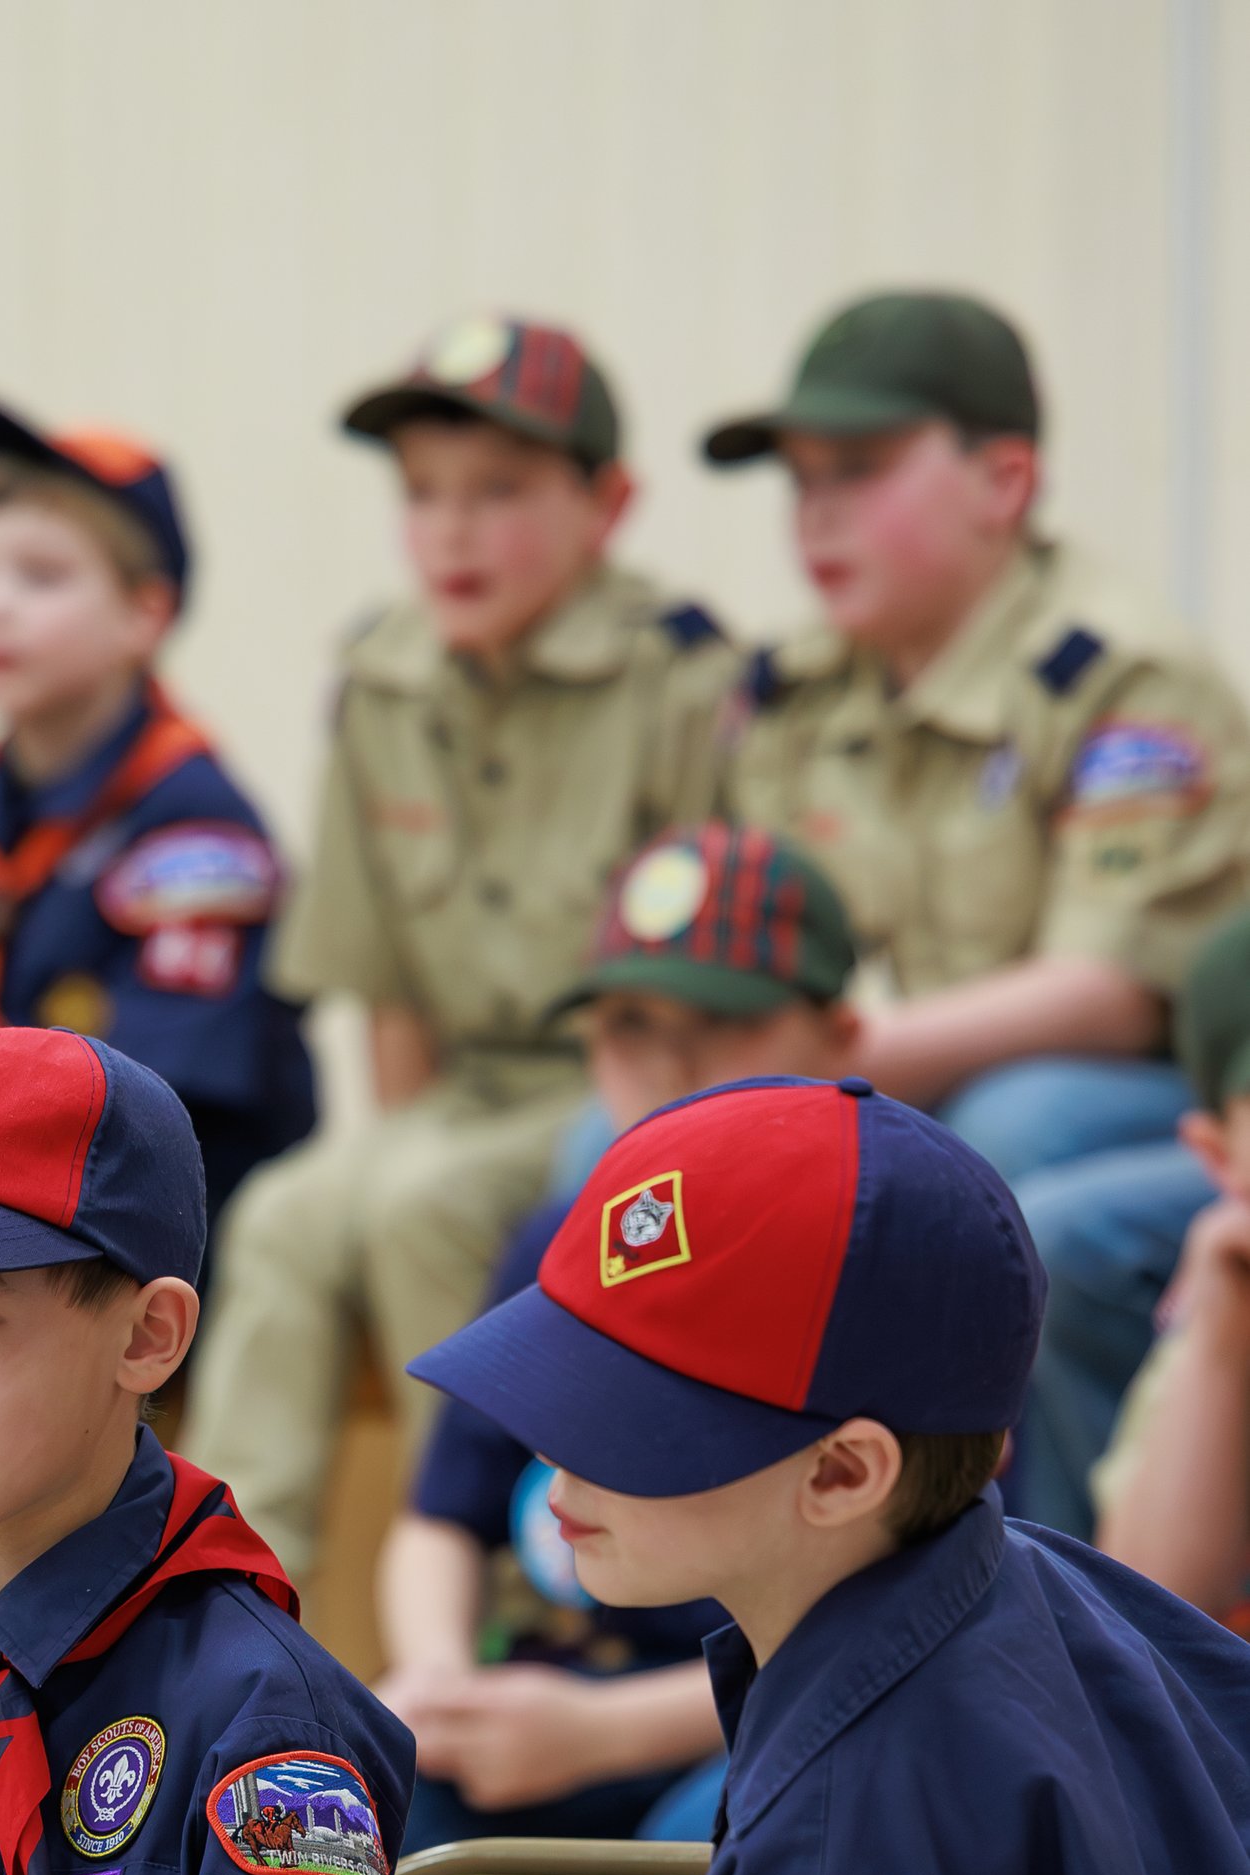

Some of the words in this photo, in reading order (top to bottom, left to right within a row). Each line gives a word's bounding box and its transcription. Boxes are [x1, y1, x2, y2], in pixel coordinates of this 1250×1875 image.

[71, 1748, 93, 1778] BOY
[91, 1720, 135, 1751] SCOUTS
[134, 1722, 145, 1733] OF
[143, 1724, 162, 1776] AMERICA
[76, 1833, 103, 1852] SINCE
[104, 1831, 125, 1850] 1910
[269, 1849, 308, 1867] TWIN
[311, 1852, 355, 1872] RIVERS
